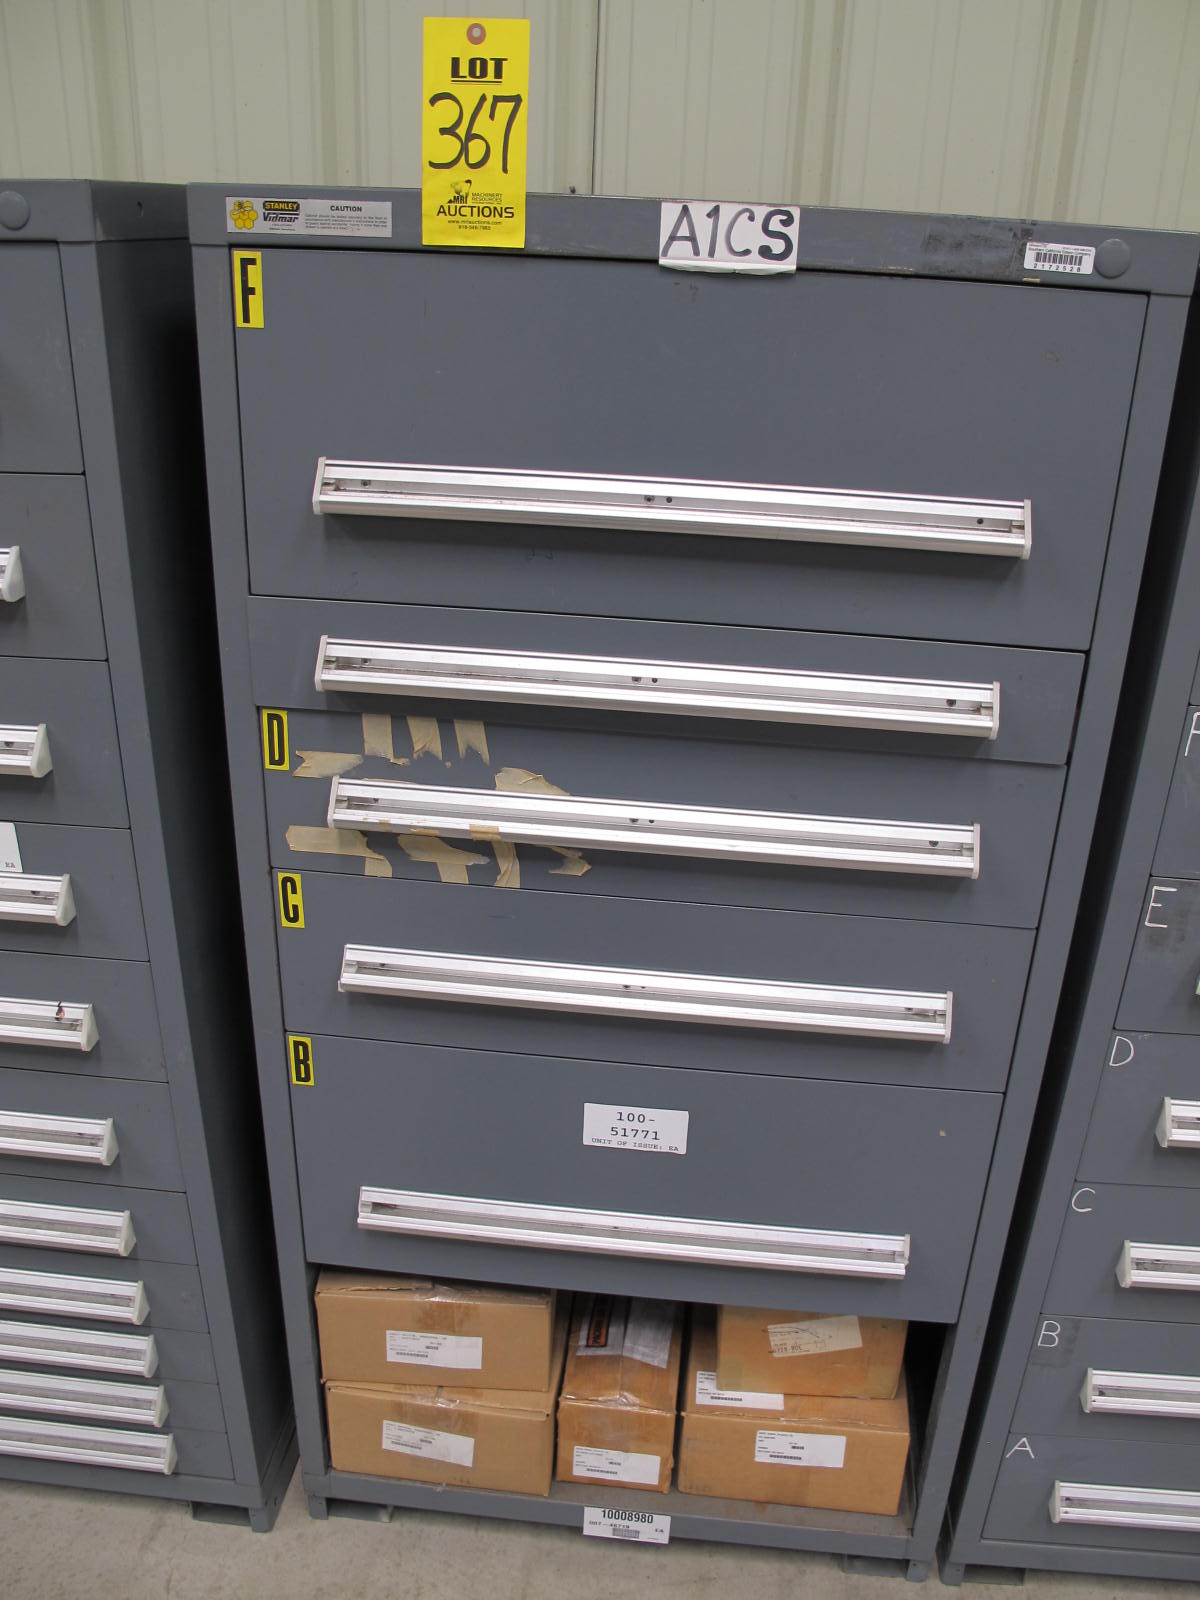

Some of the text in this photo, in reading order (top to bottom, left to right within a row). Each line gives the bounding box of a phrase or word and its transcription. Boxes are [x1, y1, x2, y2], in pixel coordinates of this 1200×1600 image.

[451, 57, 508, 80] LOT
[428, 92, 523, 174] 367
[263, 211, 299, 223] Vidmar
[265, 201, 298, 210] STANLEY
[436, 204, 515, 218] AUCTIONS
[661, 204, 795, 261] A1CS
[239, 257, 257, 324] F
[267, 713, 285, 766] D
[281, 876, 299, 924] C
[1144, 885, 1178, 928] E
[293, 1040, 311, 1083] B
[1109, 1035, 1135, 1067] D
[616, 1111, 655, 1123] 100-
[610, 1126, 660, 1141] 51771
[633, 1142, 662, 1150] ISSUE:
[1071, 1187, 1096, 1213] C
[1037, 1319, 1062, 1347] B
[1006, 1436, 1035, 1459] A
[601, 1509, 654, 1524] 10008980
